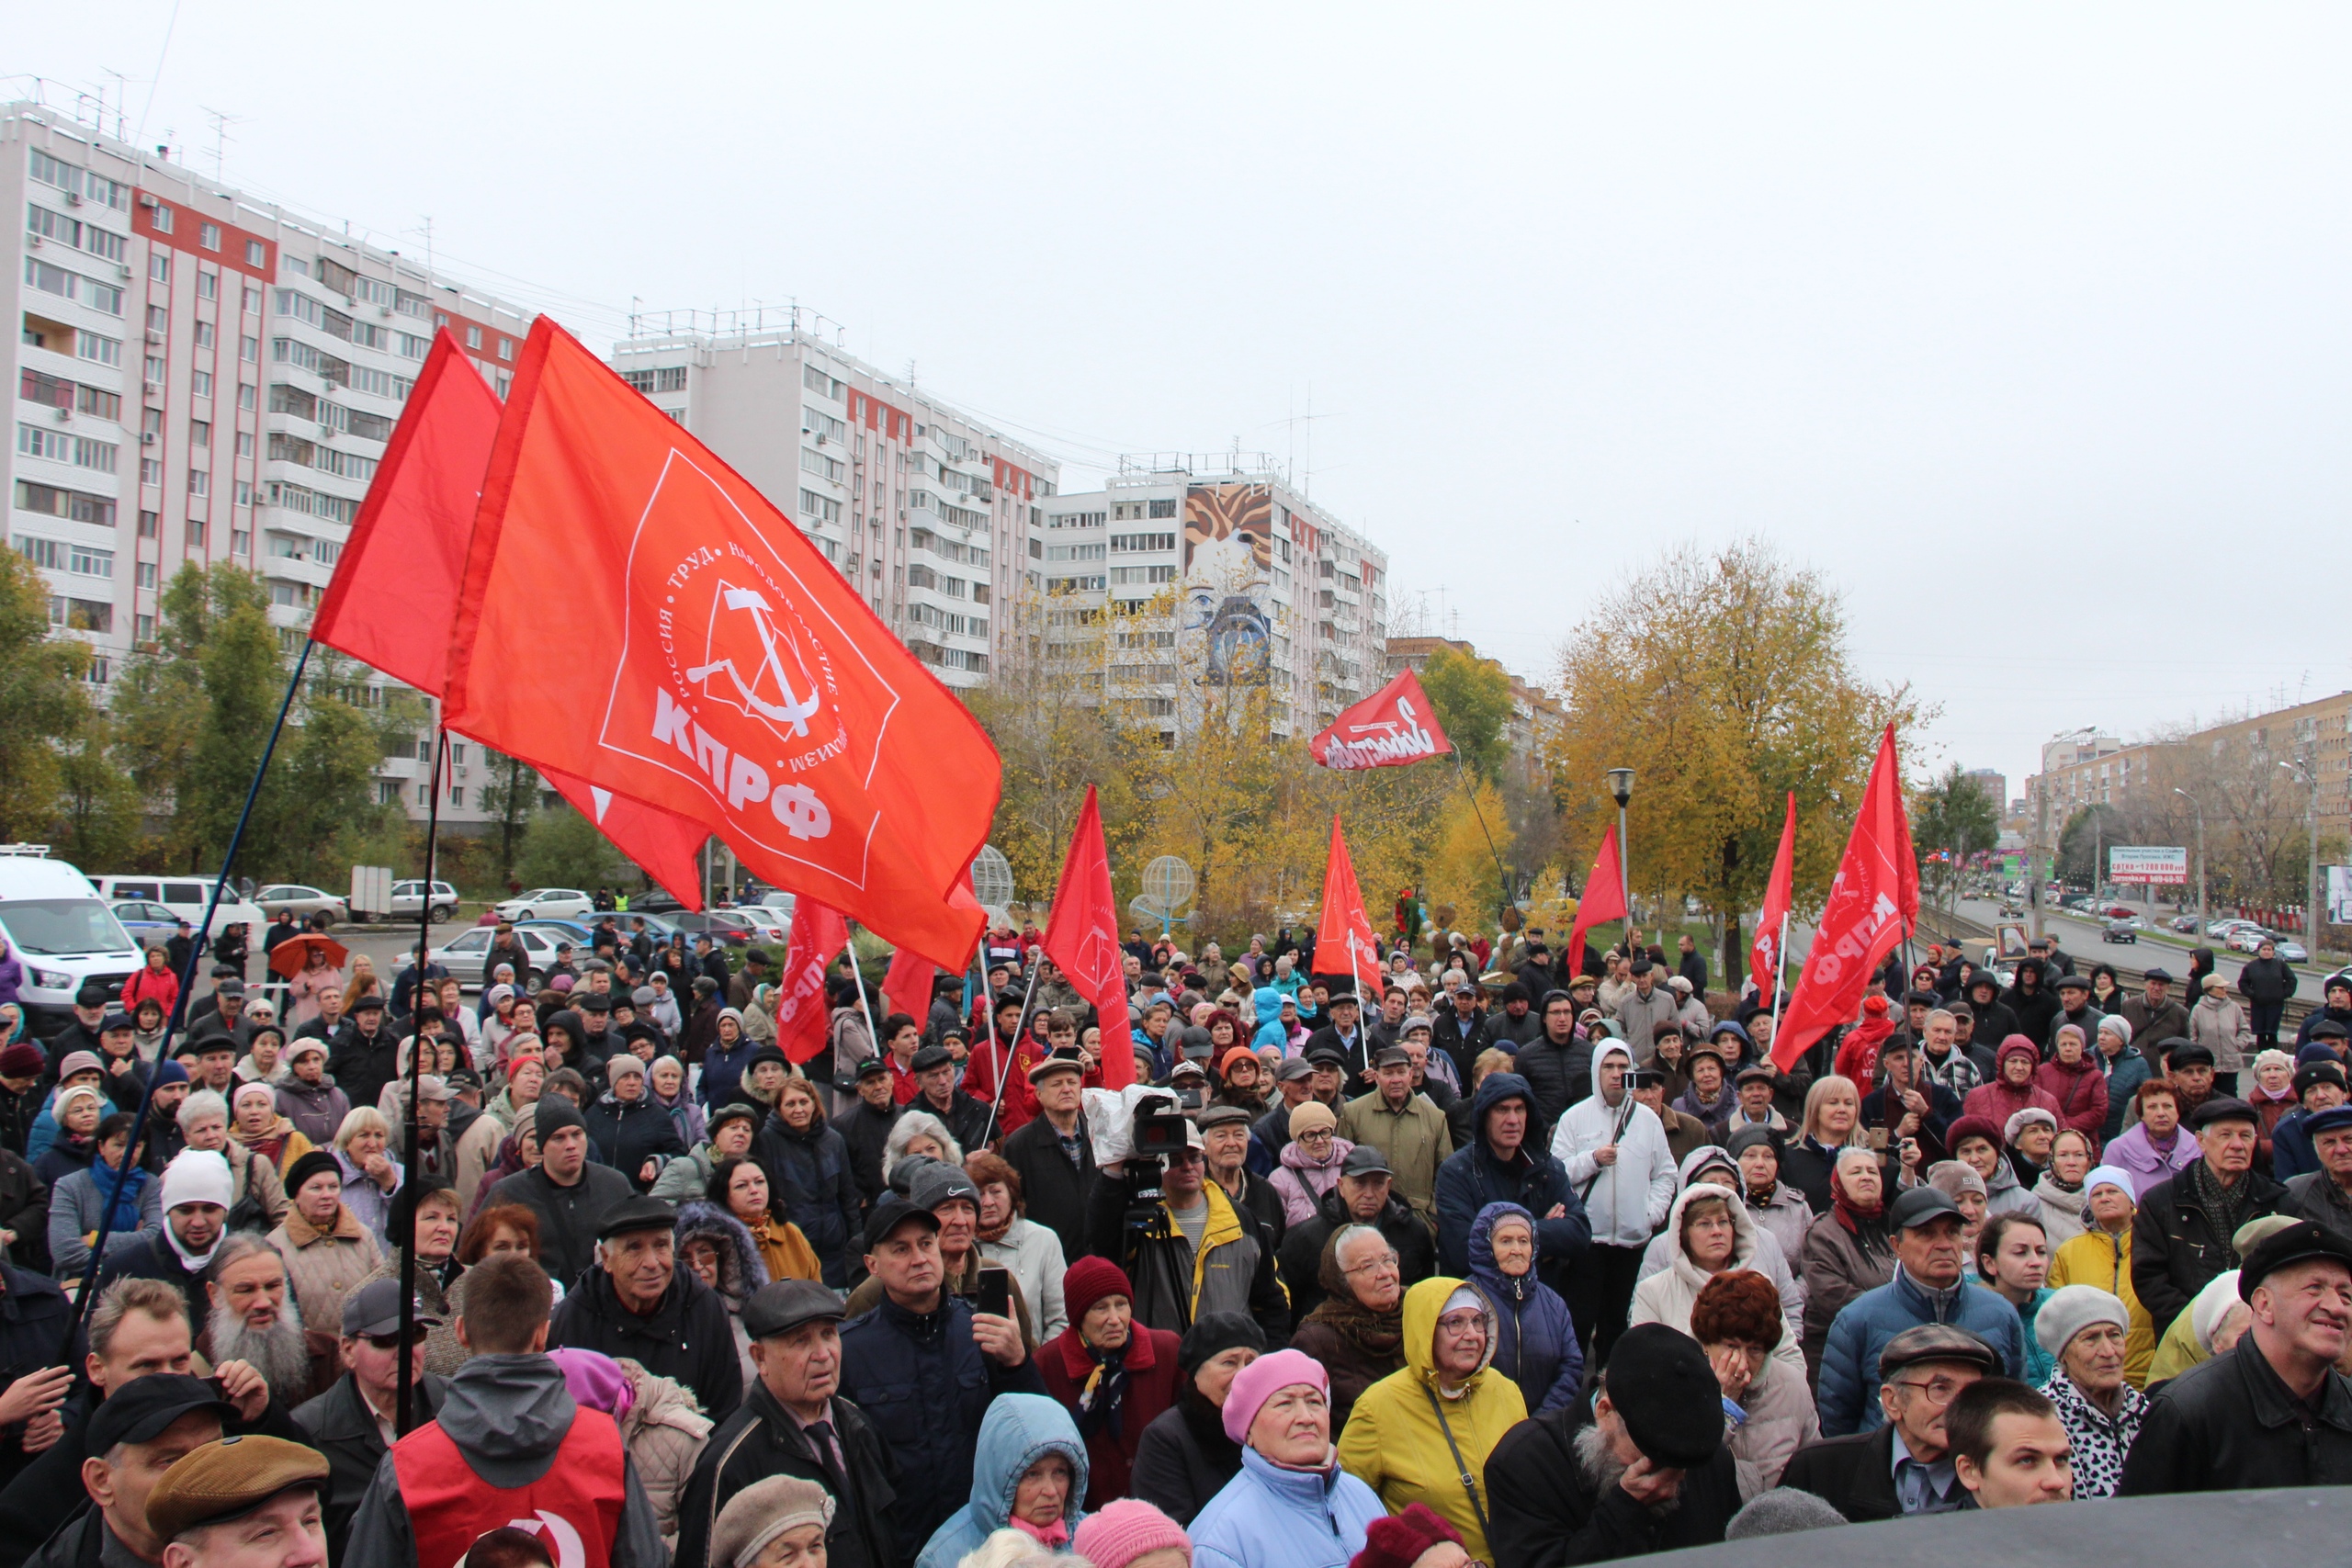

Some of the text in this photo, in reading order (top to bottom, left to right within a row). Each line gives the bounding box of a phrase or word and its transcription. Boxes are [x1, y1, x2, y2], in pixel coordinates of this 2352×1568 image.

[667, 546, 715, 590] ТРУД
[659, 607, 690, 698] РОССИЯ
[651, 685, 831, 842] КПРФ
